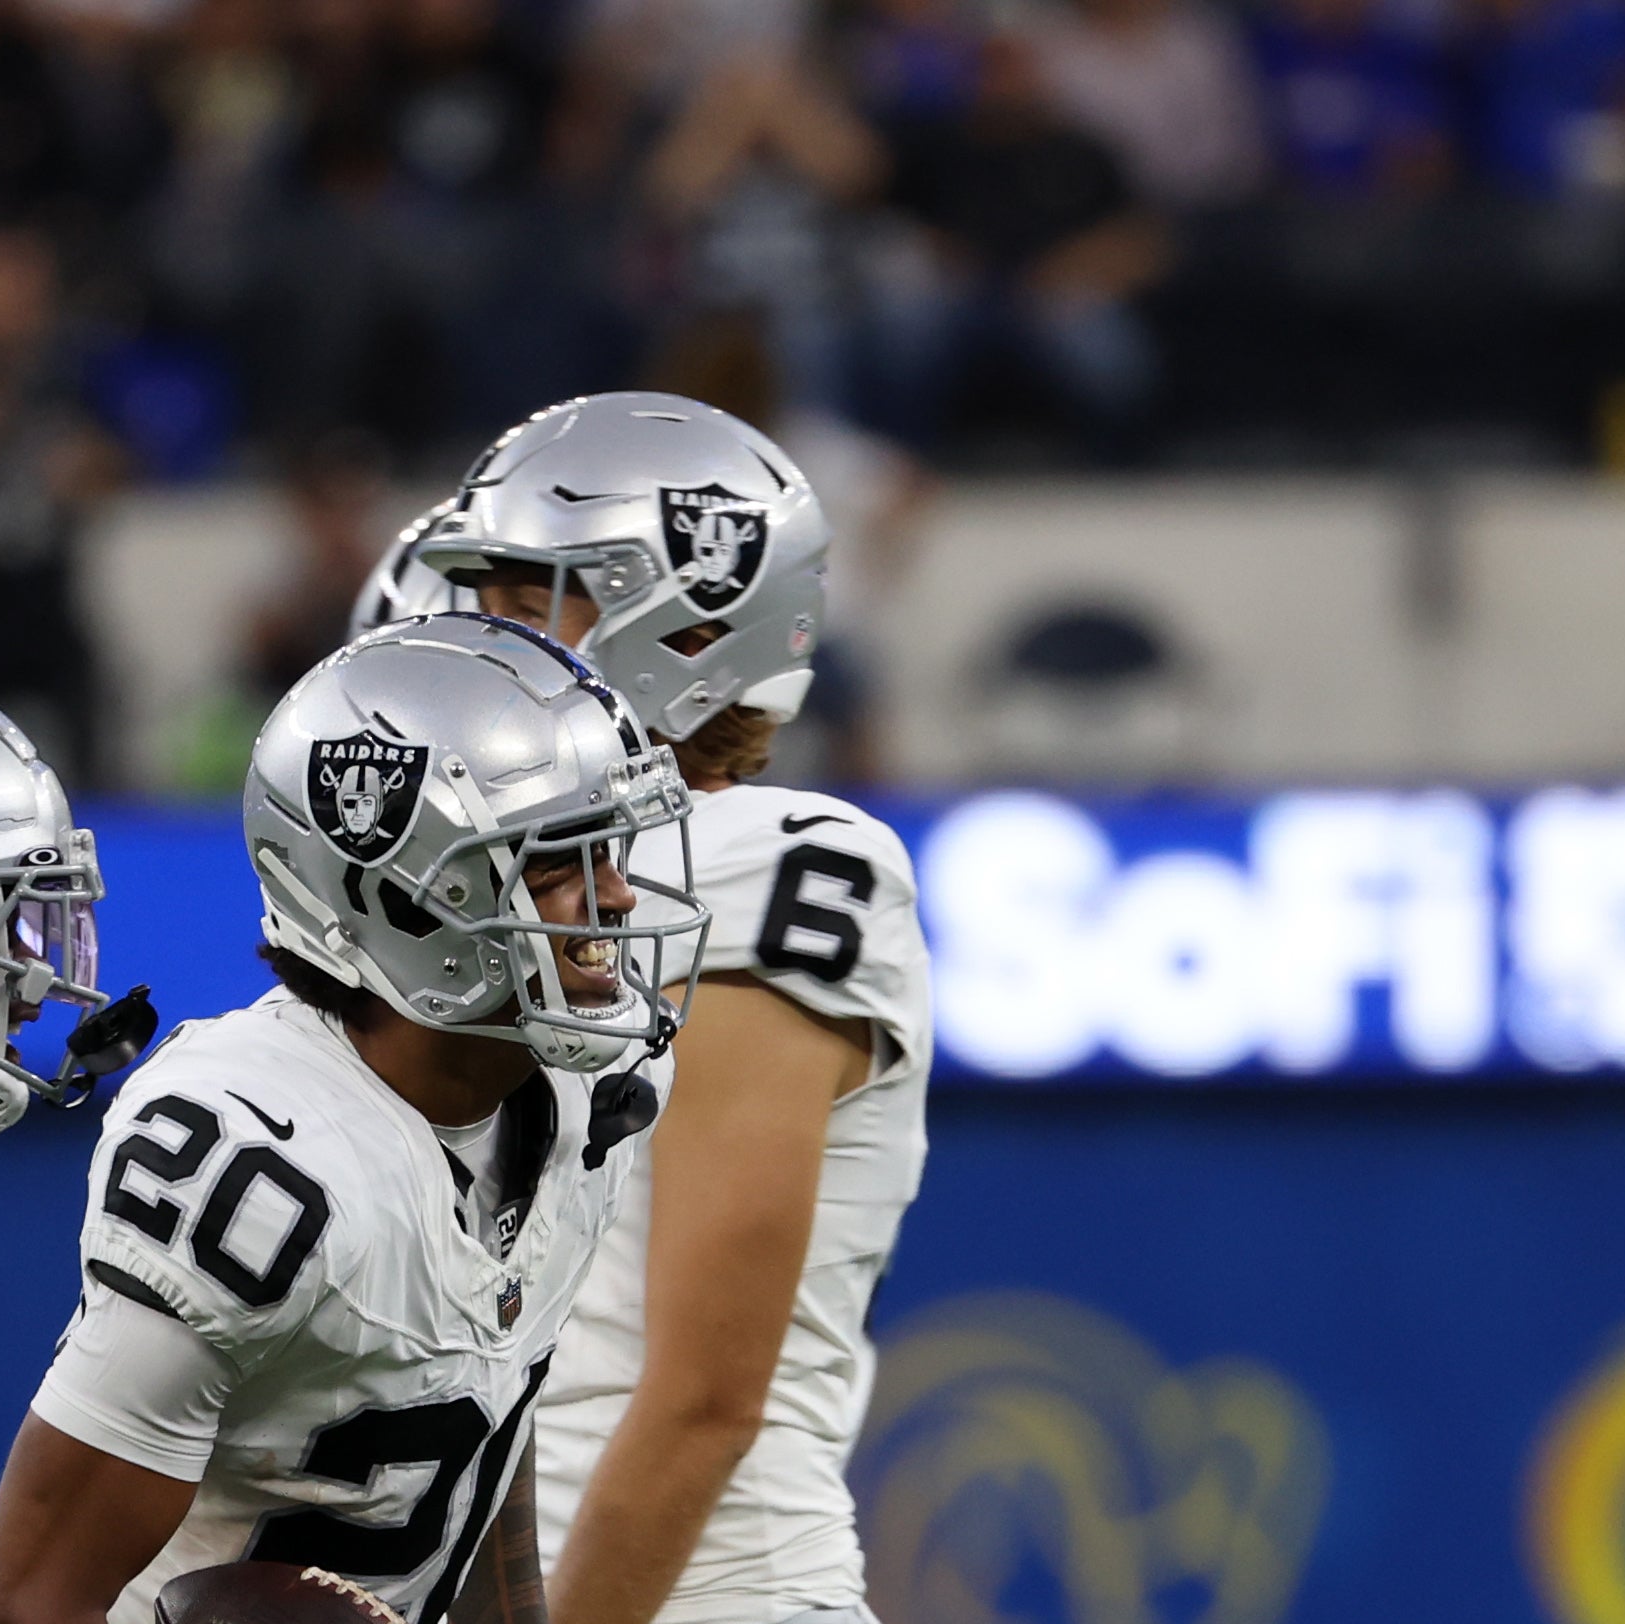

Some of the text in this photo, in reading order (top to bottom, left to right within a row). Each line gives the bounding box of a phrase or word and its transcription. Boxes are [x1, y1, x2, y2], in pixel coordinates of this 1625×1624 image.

[668, 491, 768, 517] RAID
[319, 743, 416, 764] RAIDERS
[755, 840, 878, 984] 6
[921, 790, 1498, 1078] SoFi
[101, 1094, 331, 1304] 20
